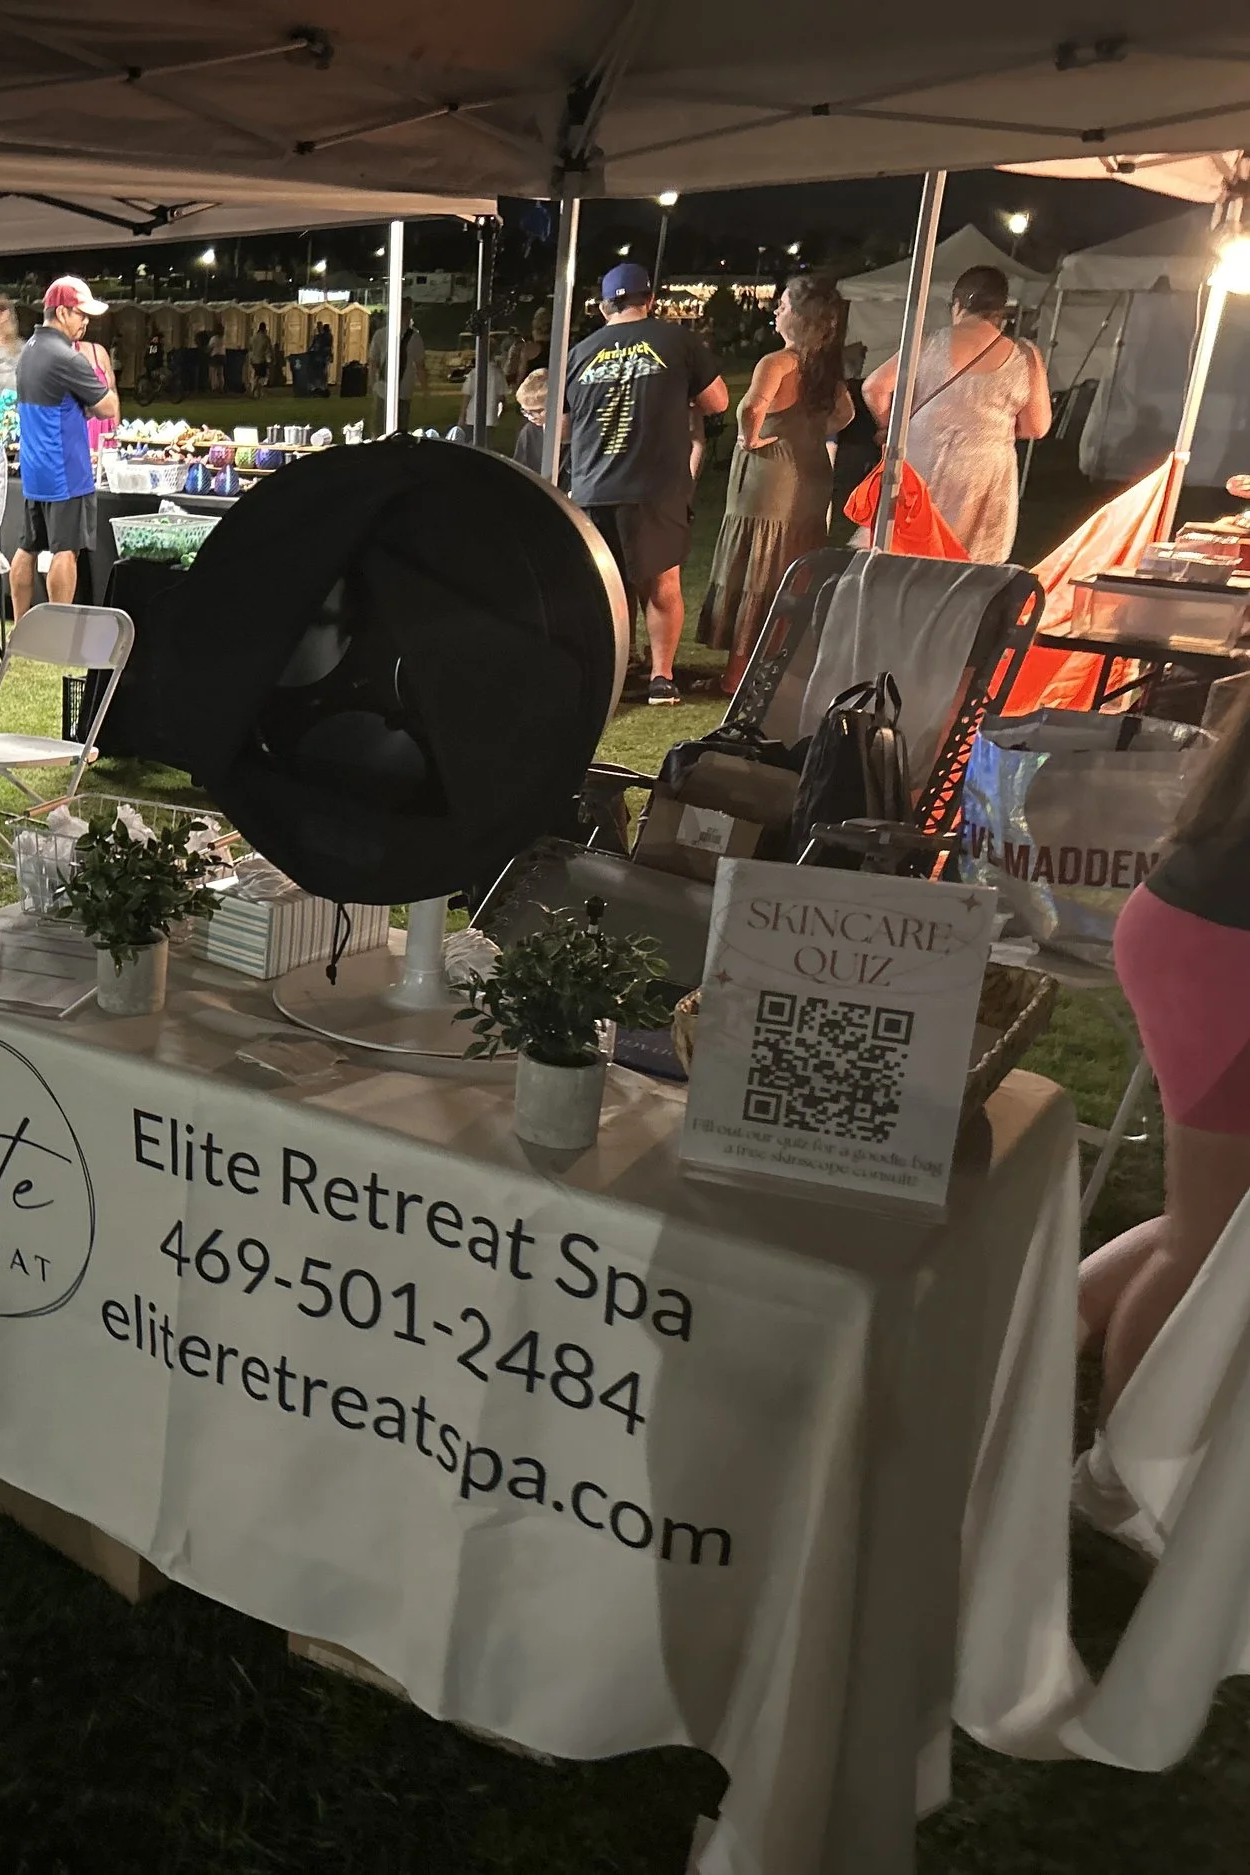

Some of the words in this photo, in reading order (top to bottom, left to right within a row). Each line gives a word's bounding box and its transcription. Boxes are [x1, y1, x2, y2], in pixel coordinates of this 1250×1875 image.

[746, 900, 953, 954] SKINCARE
[793, 946, 896, 988] QUIZ
[716, 1124, 742, 1139] out
[776, 1134, 808, 1150] quiz
[812, 1137, 836, 1154] for
[133, 1107, 261, 1195] Elite
[281, 1146, 536, 1280] Retreat
[554, 1232, 693, 1342] Spa
[159, 1219, 646, 1436] 469-501-2484
[102, 1293, 732, 1567] eliteretreatspa.com
